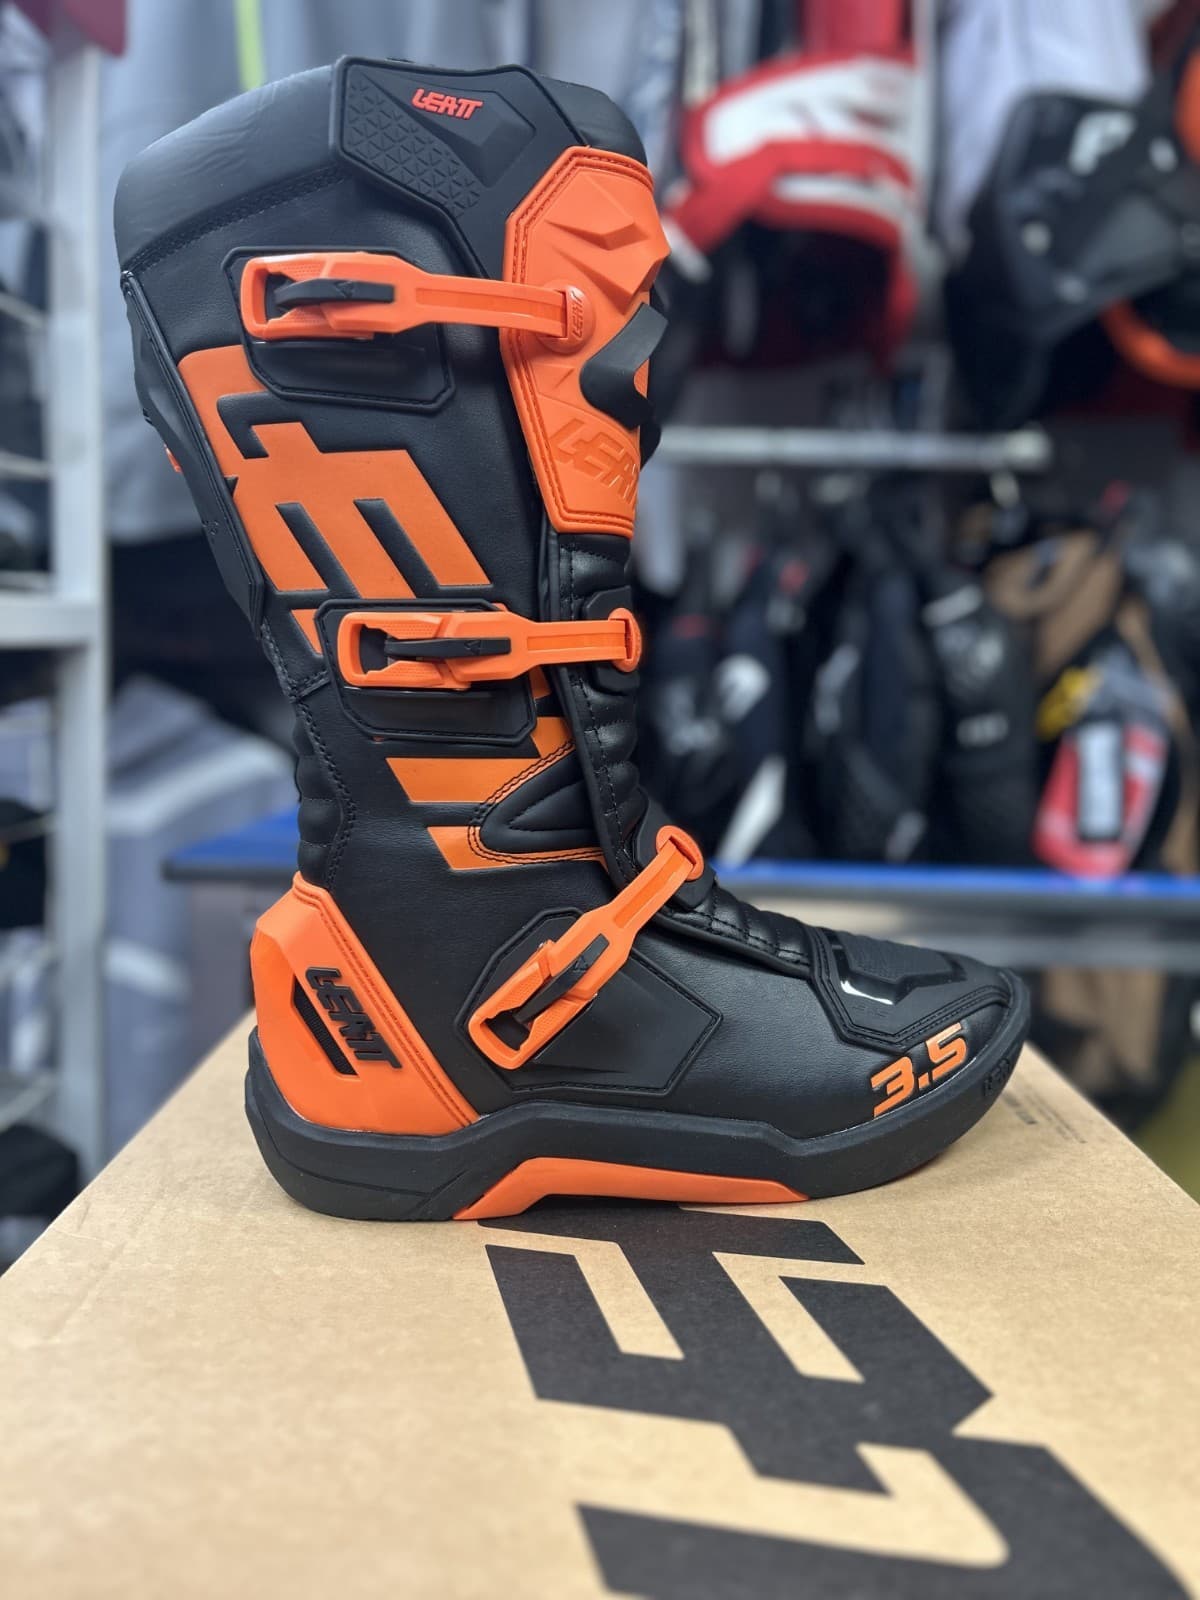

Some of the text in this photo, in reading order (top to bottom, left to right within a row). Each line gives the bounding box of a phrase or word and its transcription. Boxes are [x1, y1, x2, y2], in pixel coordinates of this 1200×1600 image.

[411, 88, 484, 120] LEATT
[305, 967, 402, 1069] LEATT
[871, 1021, 967, 1119] 3.5
